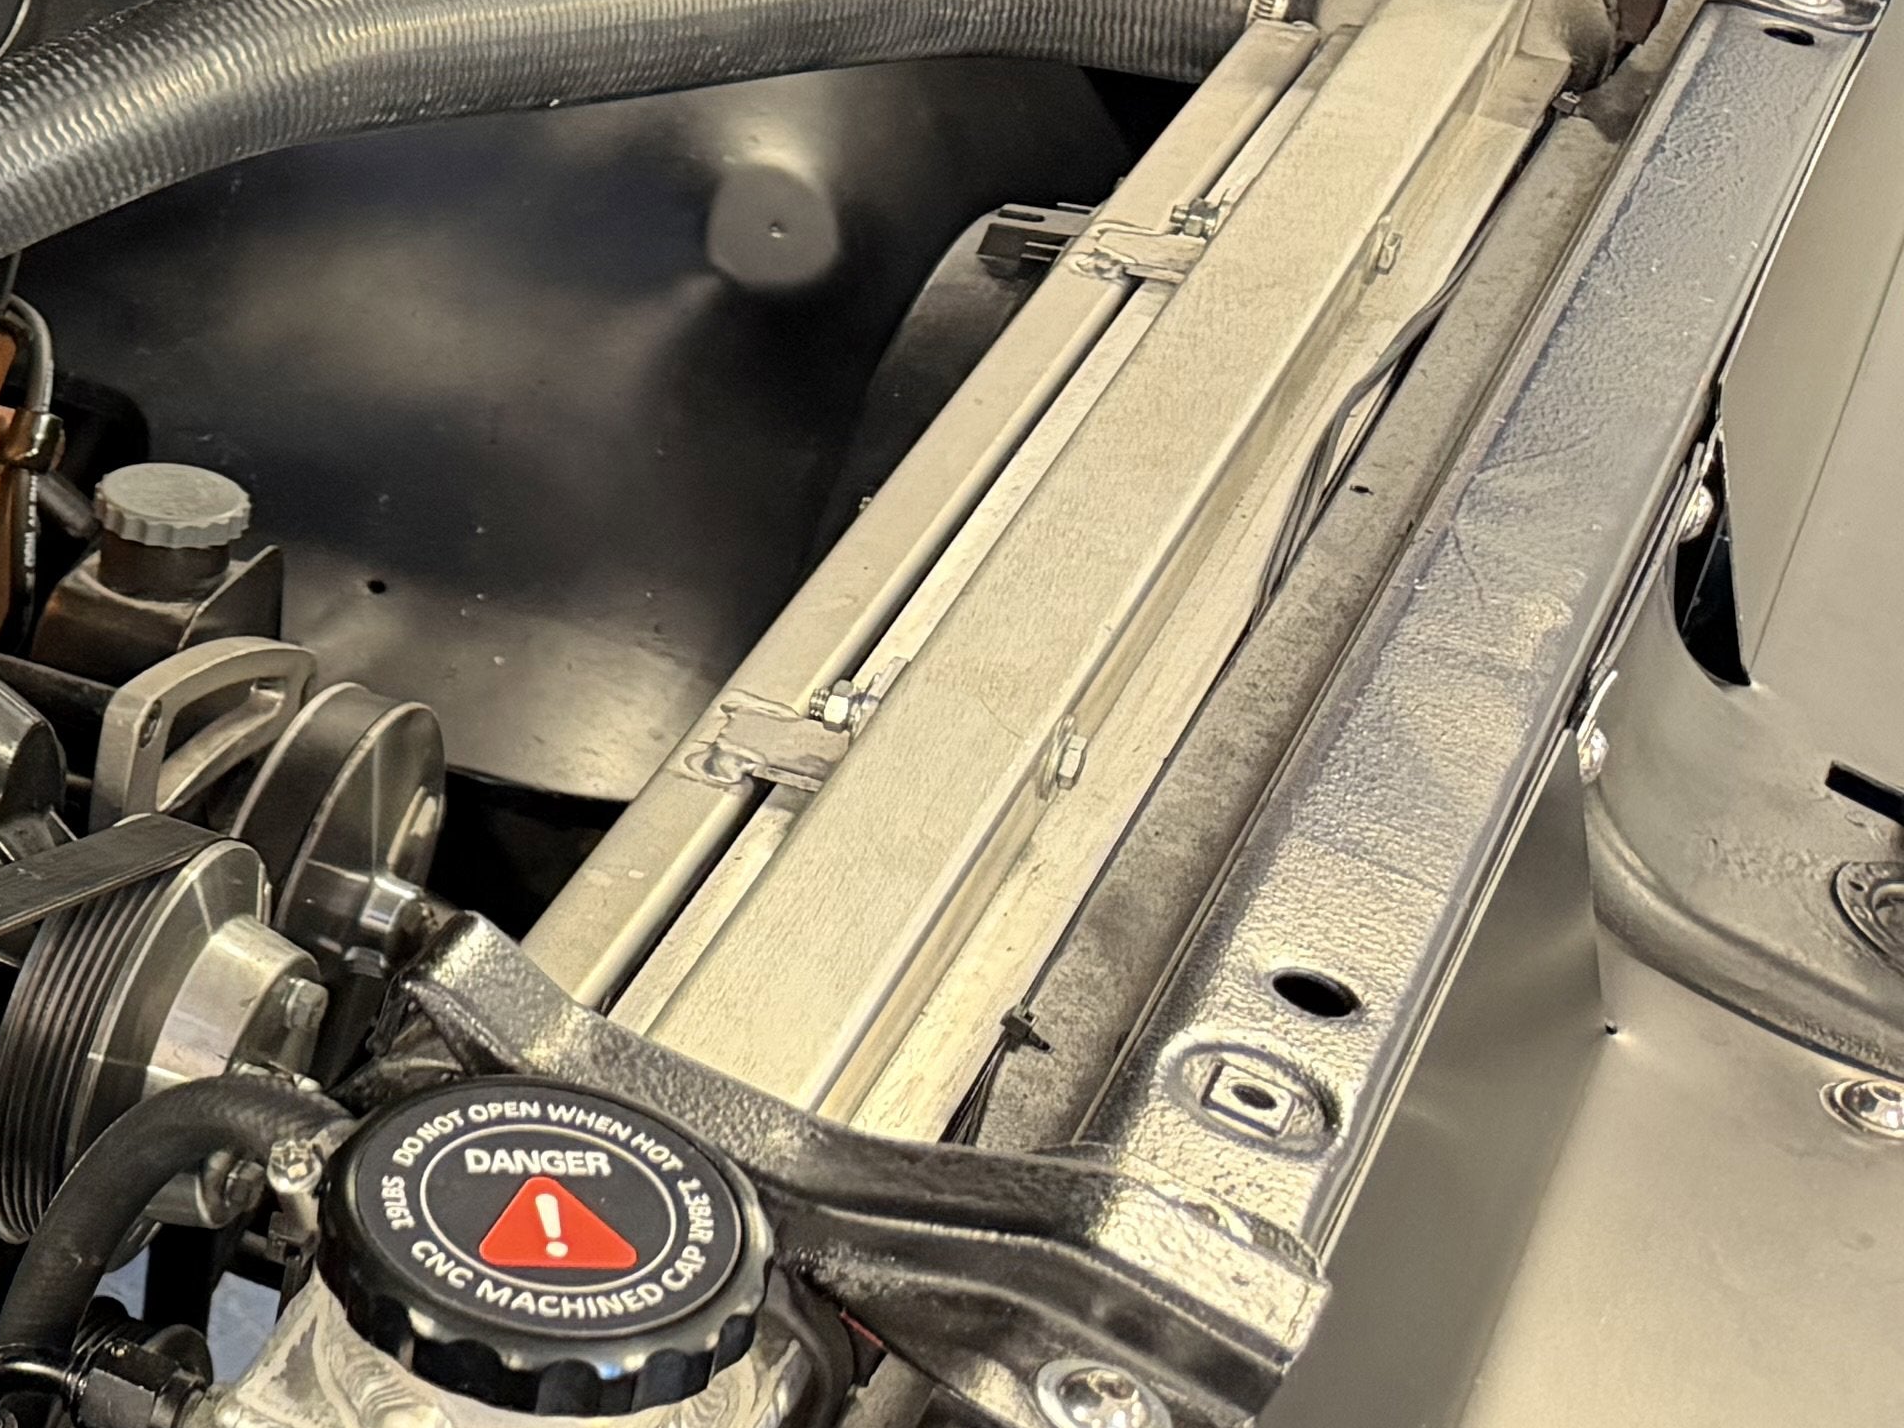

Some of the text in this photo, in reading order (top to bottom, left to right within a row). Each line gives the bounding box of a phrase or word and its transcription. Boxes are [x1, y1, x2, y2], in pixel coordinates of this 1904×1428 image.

[392, 1101, 684, 1172] DO NOT OPEN WHEN HOT
[465, 1148, 612, 1177] DANGER
[411, 1240, 707, 1319] CNC MACHINED CAP
